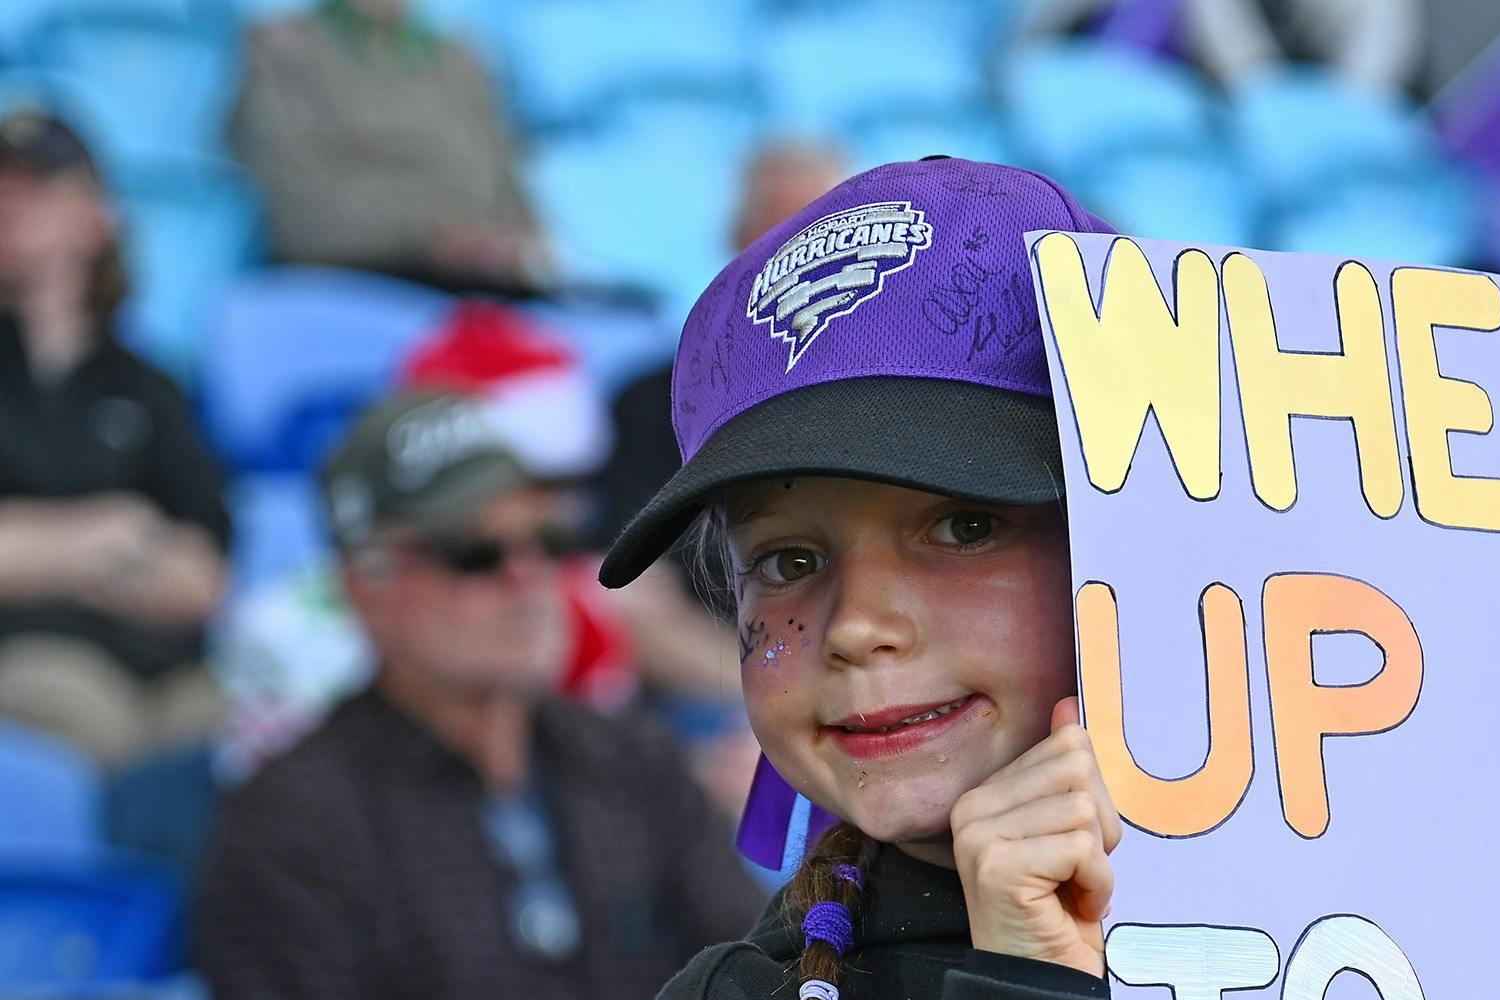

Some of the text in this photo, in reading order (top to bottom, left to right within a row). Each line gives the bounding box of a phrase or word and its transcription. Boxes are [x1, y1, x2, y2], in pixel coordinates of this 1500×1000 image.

[750, 222, 926, 307] HURRICANES
[806, 214, 866, 239] HOBART
[1075, 571, 1425, 840] UP
